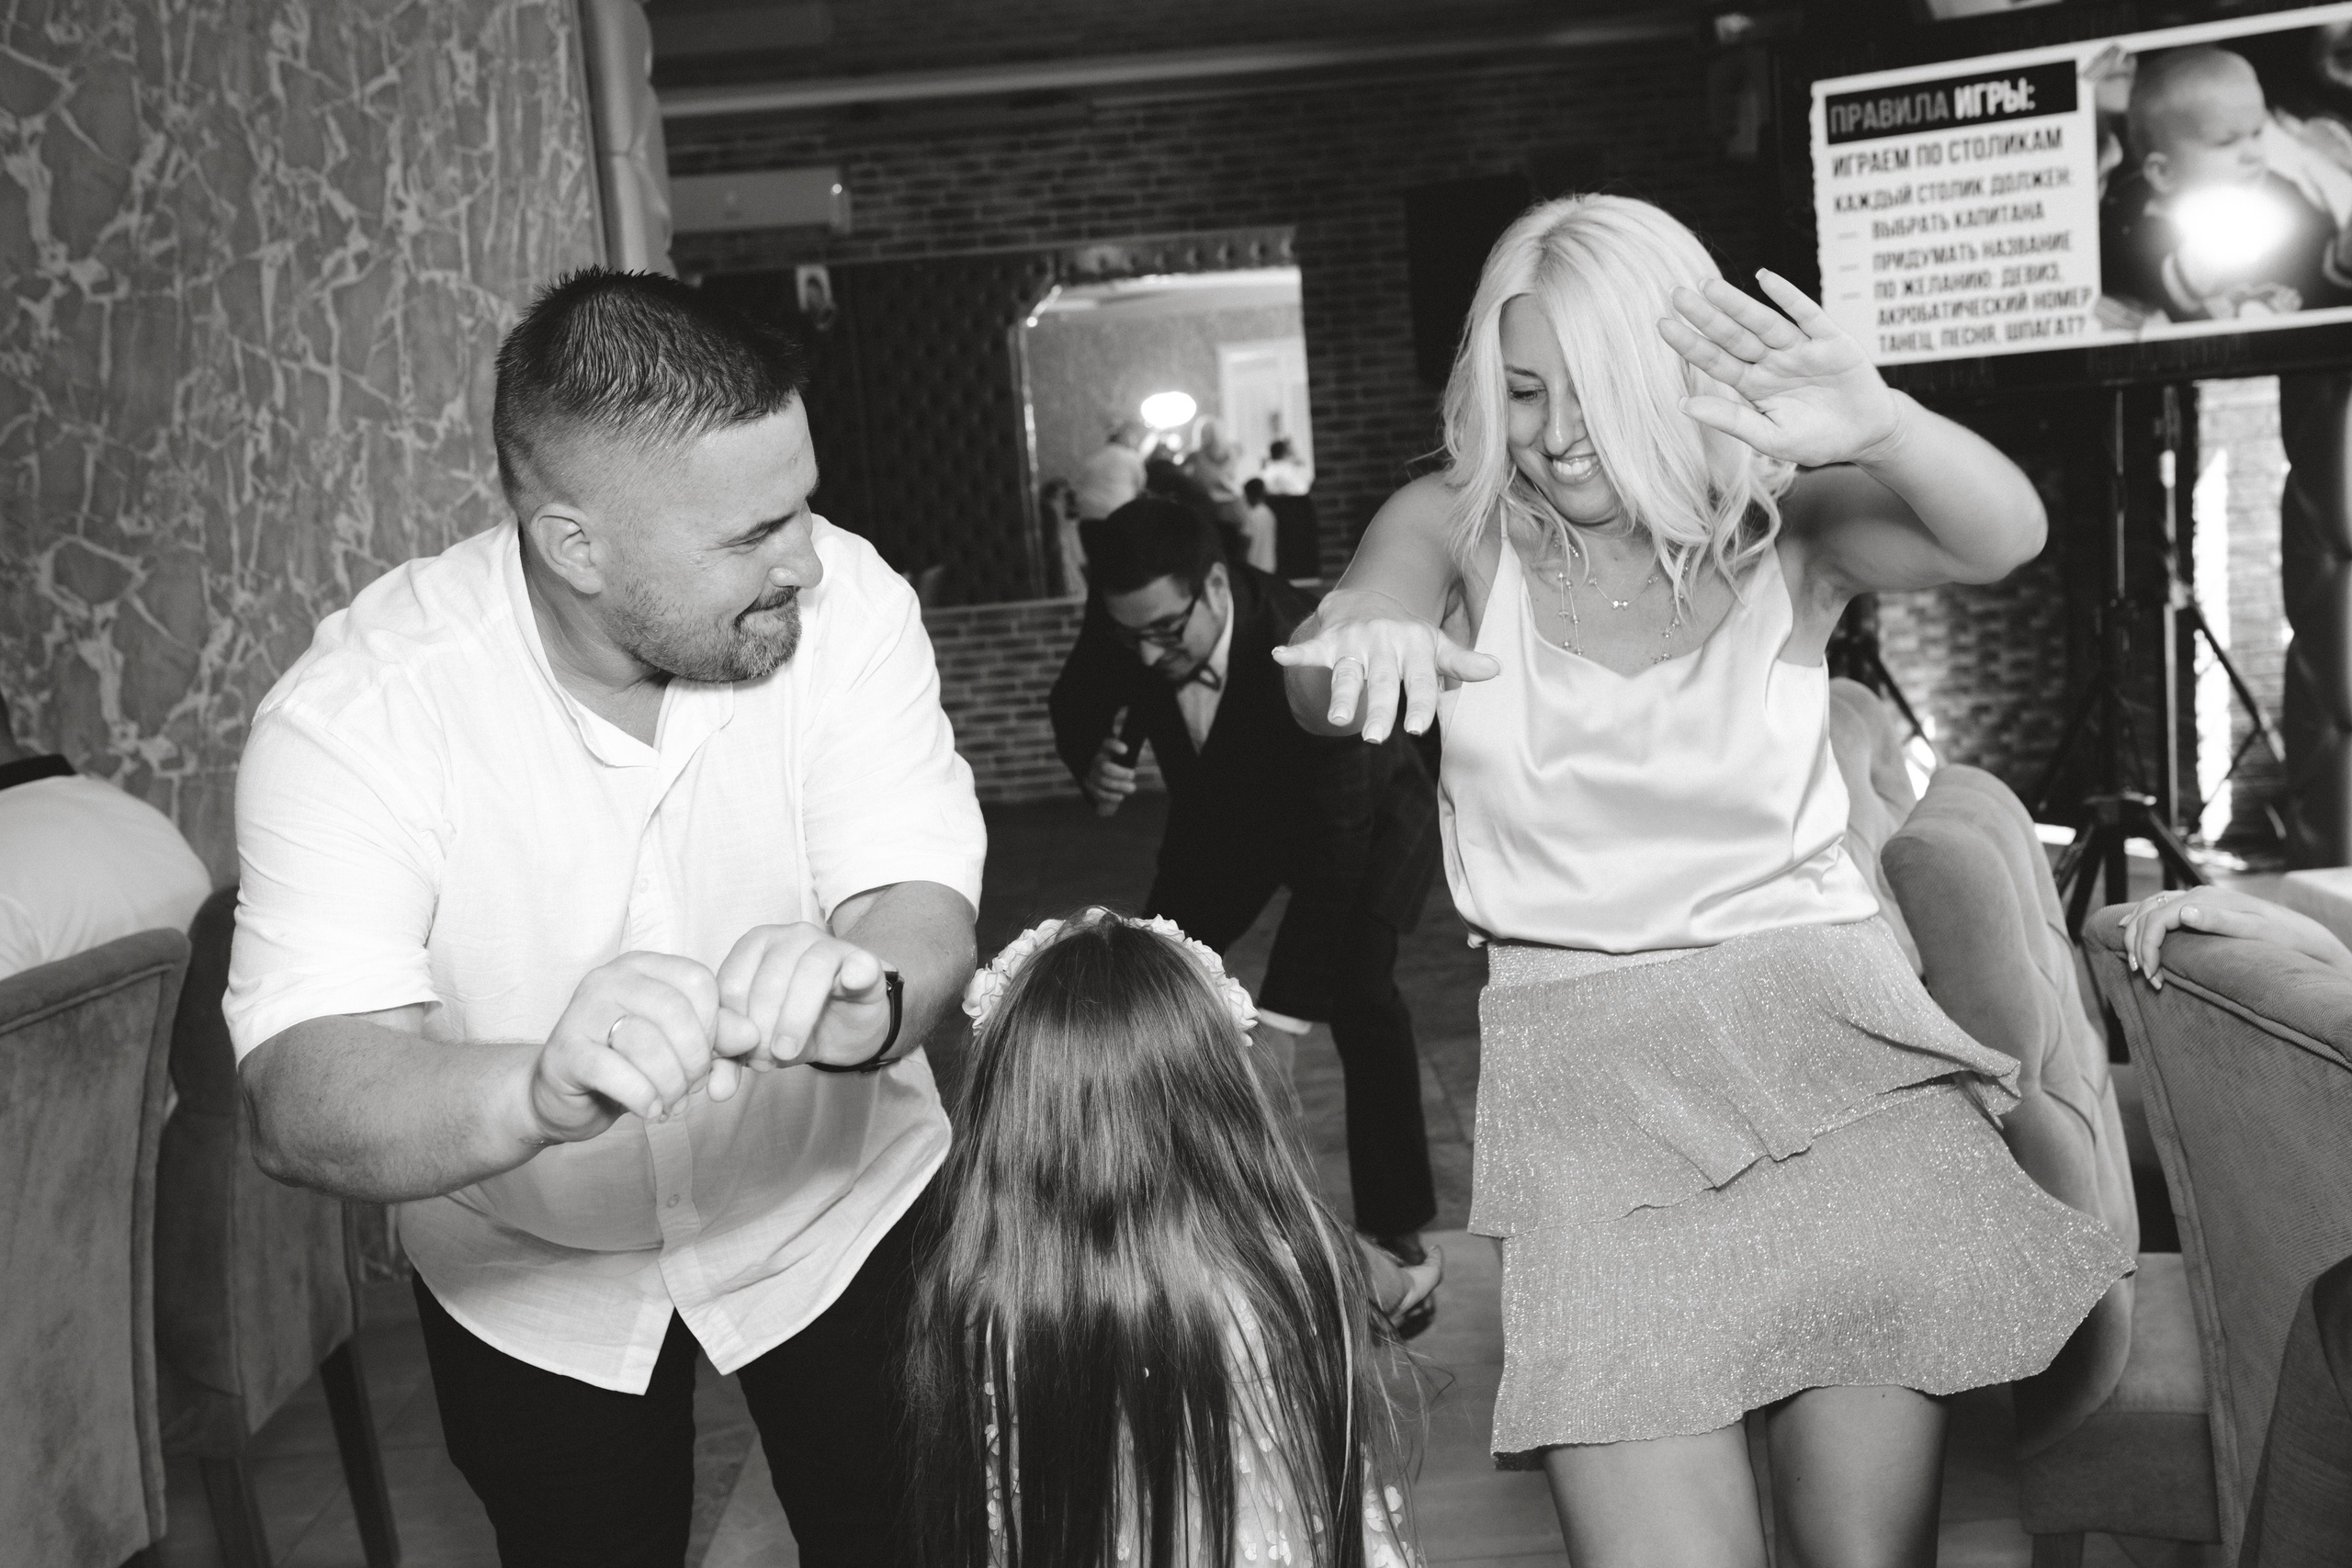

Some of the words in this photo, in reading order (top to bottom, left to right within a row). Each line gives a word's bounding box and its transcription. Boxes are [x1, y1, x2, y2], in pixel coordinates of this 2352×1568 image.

[1829, 91, 1950, 134] ПРАВИЛА
[1953, 77, 2036, 120] ИГРЫ:
[1833, 148, 1909, 178] ИГРАЕМ
[1917, 142, 1943, 167] ПО
[1948, 127, 2064, 164] СТОЛИКАМ
[1834, 185, 1912, 213] КАЖДЫЙ
[1917, 178, 1984, 204] СТОЛИК
[1872, 213, 1950, 240] ВЫБРАТЬ
[1954, 202, 2045, 229] КАПИТАНА
[1872, 243, 1977, 272] ПРИДУМАТЬ
[1981, 231, 2070, 259] НАЗВАНИЕ
[1874, 281, 1895, 300] ПО
[1877, 292, 2029, 326] АКРОБАТИЧЕСКИЙ
